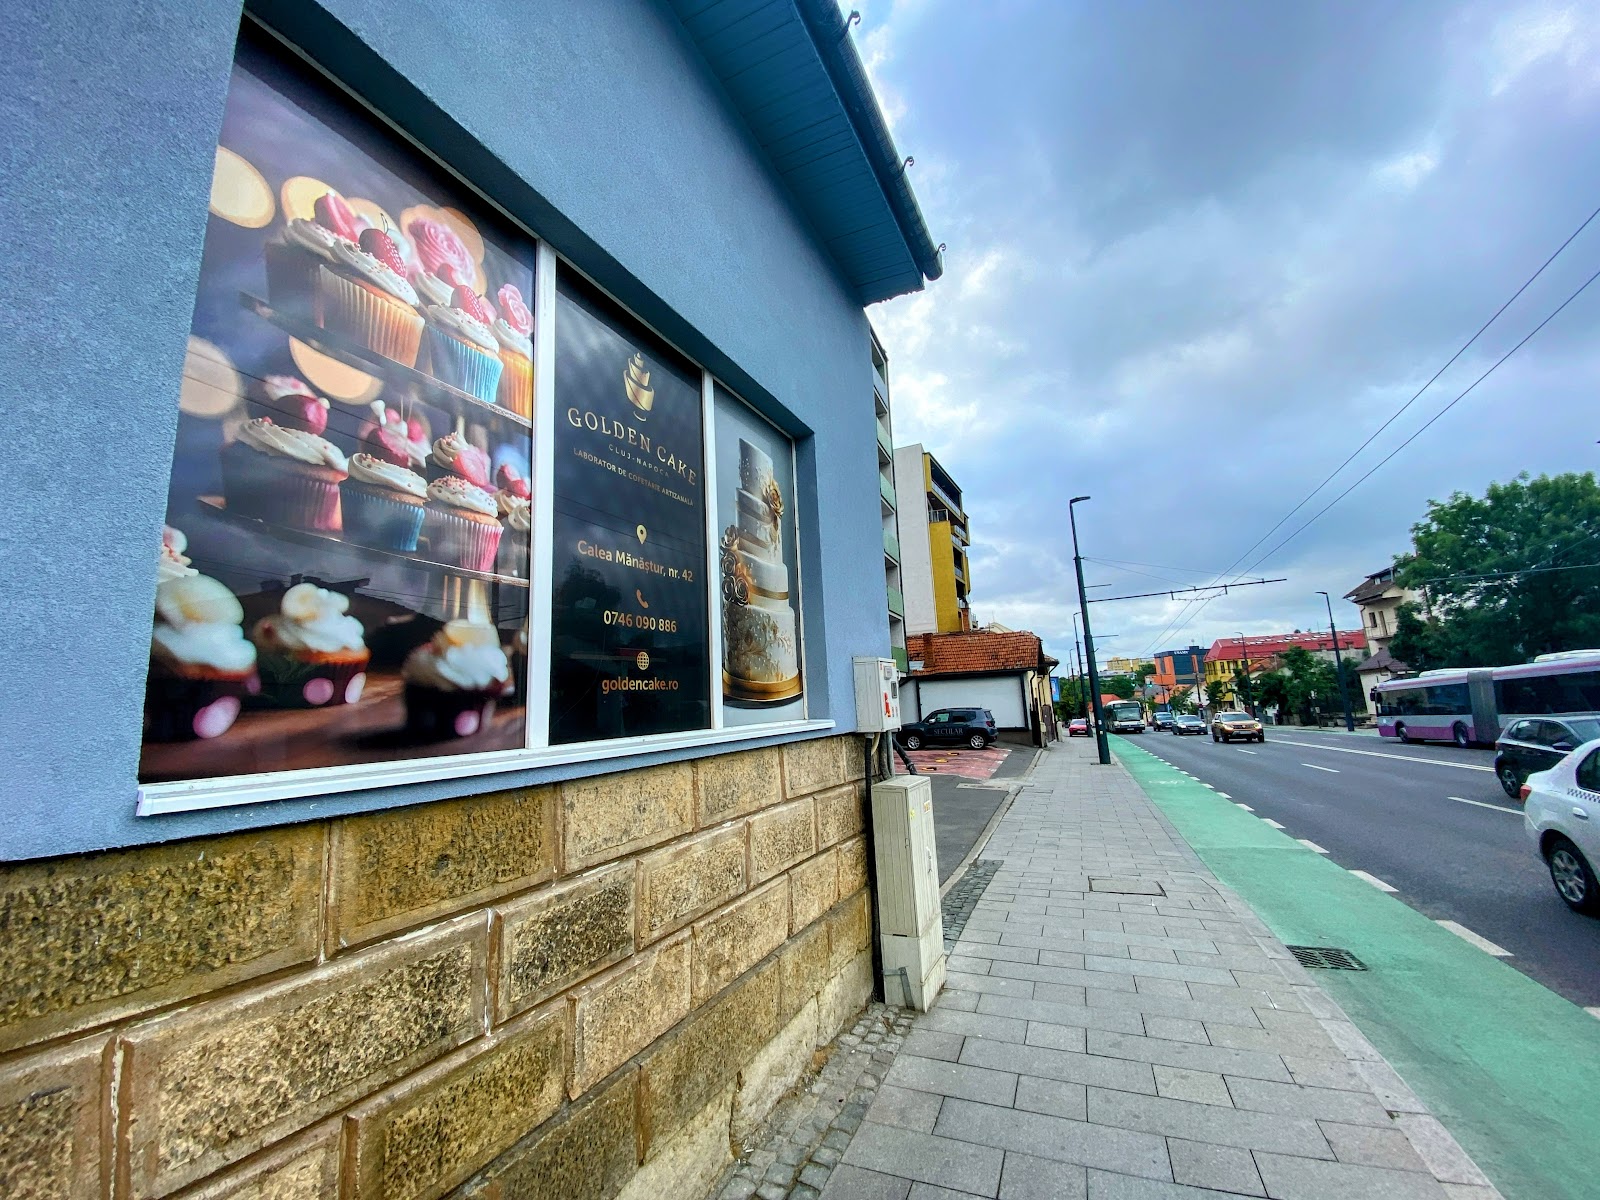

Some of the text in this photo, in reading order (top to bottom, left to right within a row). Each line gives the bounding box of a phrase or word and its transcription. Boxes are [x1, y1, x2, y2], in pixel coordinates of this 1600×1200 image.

[567, 407, 697, 486] GOLDEN CAKE
[573, 448, 616, 472] LABORATOR
[618, 467, 627, 477] DE
[608, 443, 669, 478] CLUJ-NAPOCA
[577, 540, 612, 562] Calea
[668, 567, 680, 579] nr.
[682, 569, 693, 582] 42
[603, 610, 677, 632] 0746 090 886
[602, 676, 679, 694] goldencake.ro
